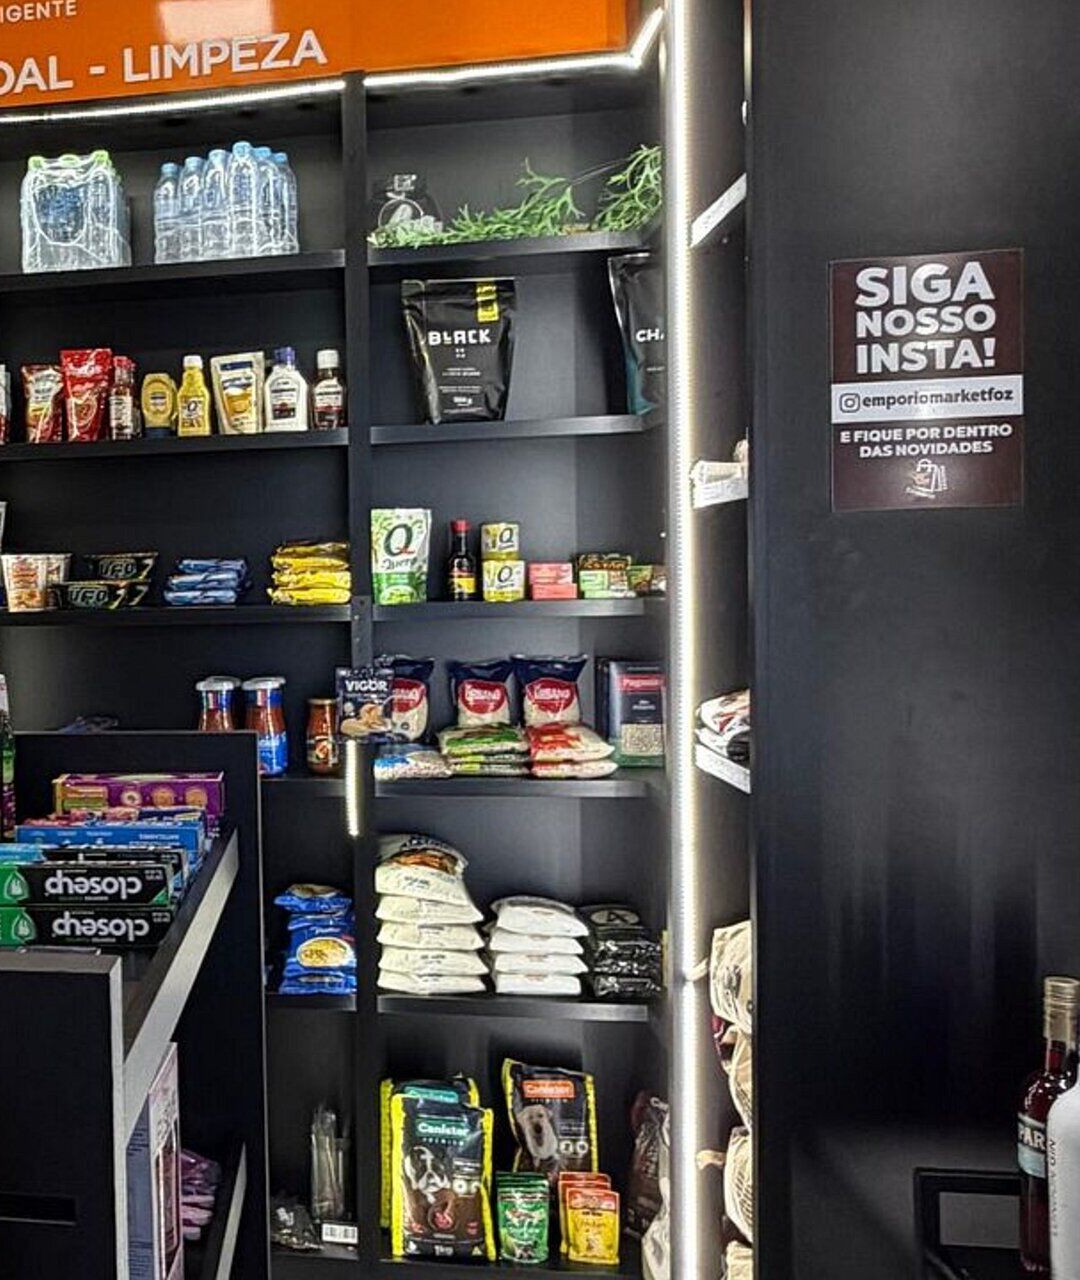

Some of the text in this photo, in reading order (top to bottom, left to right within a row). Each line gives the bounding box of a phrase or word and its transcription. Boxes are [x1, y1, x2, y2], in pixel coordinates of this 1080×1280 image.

[123, 29, 328, 84] LIMPEZA
[855, 261, 996, 308] SIGA
[856, 304, 996, 338] NOSSO
[427, 328, 492, 346] BLACK
[856, 337, 996, 374] INSTA!
[862, 387, 1014, 410] emporiomarketfoz
[840, 423, 1013, 444] E FIQUE POR DENTRO
[859, 440, 994, 458] DAS NOVIDADES
[44, 869, 142, 900] closeup
[52, 910, 149, 942] closeup
